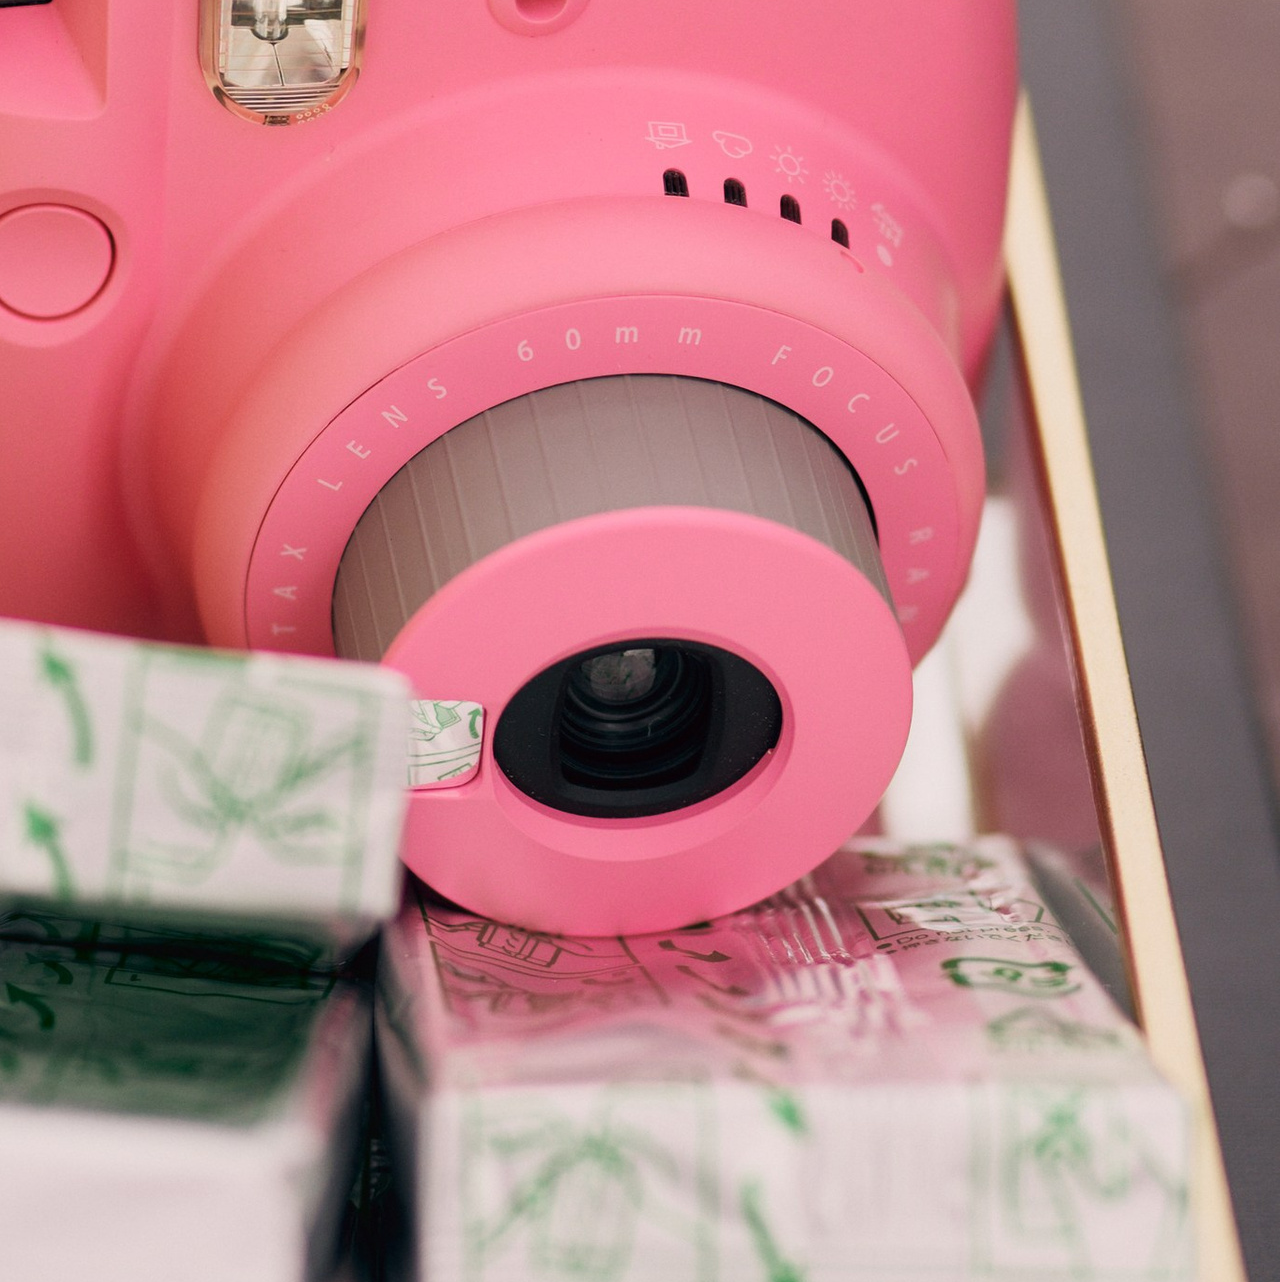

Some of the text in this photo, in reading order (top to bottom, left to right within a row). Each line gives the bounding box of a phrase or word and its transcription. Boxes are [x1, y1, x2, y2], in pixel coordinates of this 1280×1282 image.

[317, 378, 448, 491] LENS
[517, 326, 703, 362] 60mm
[771, 345, 919, 476] FOCUS
